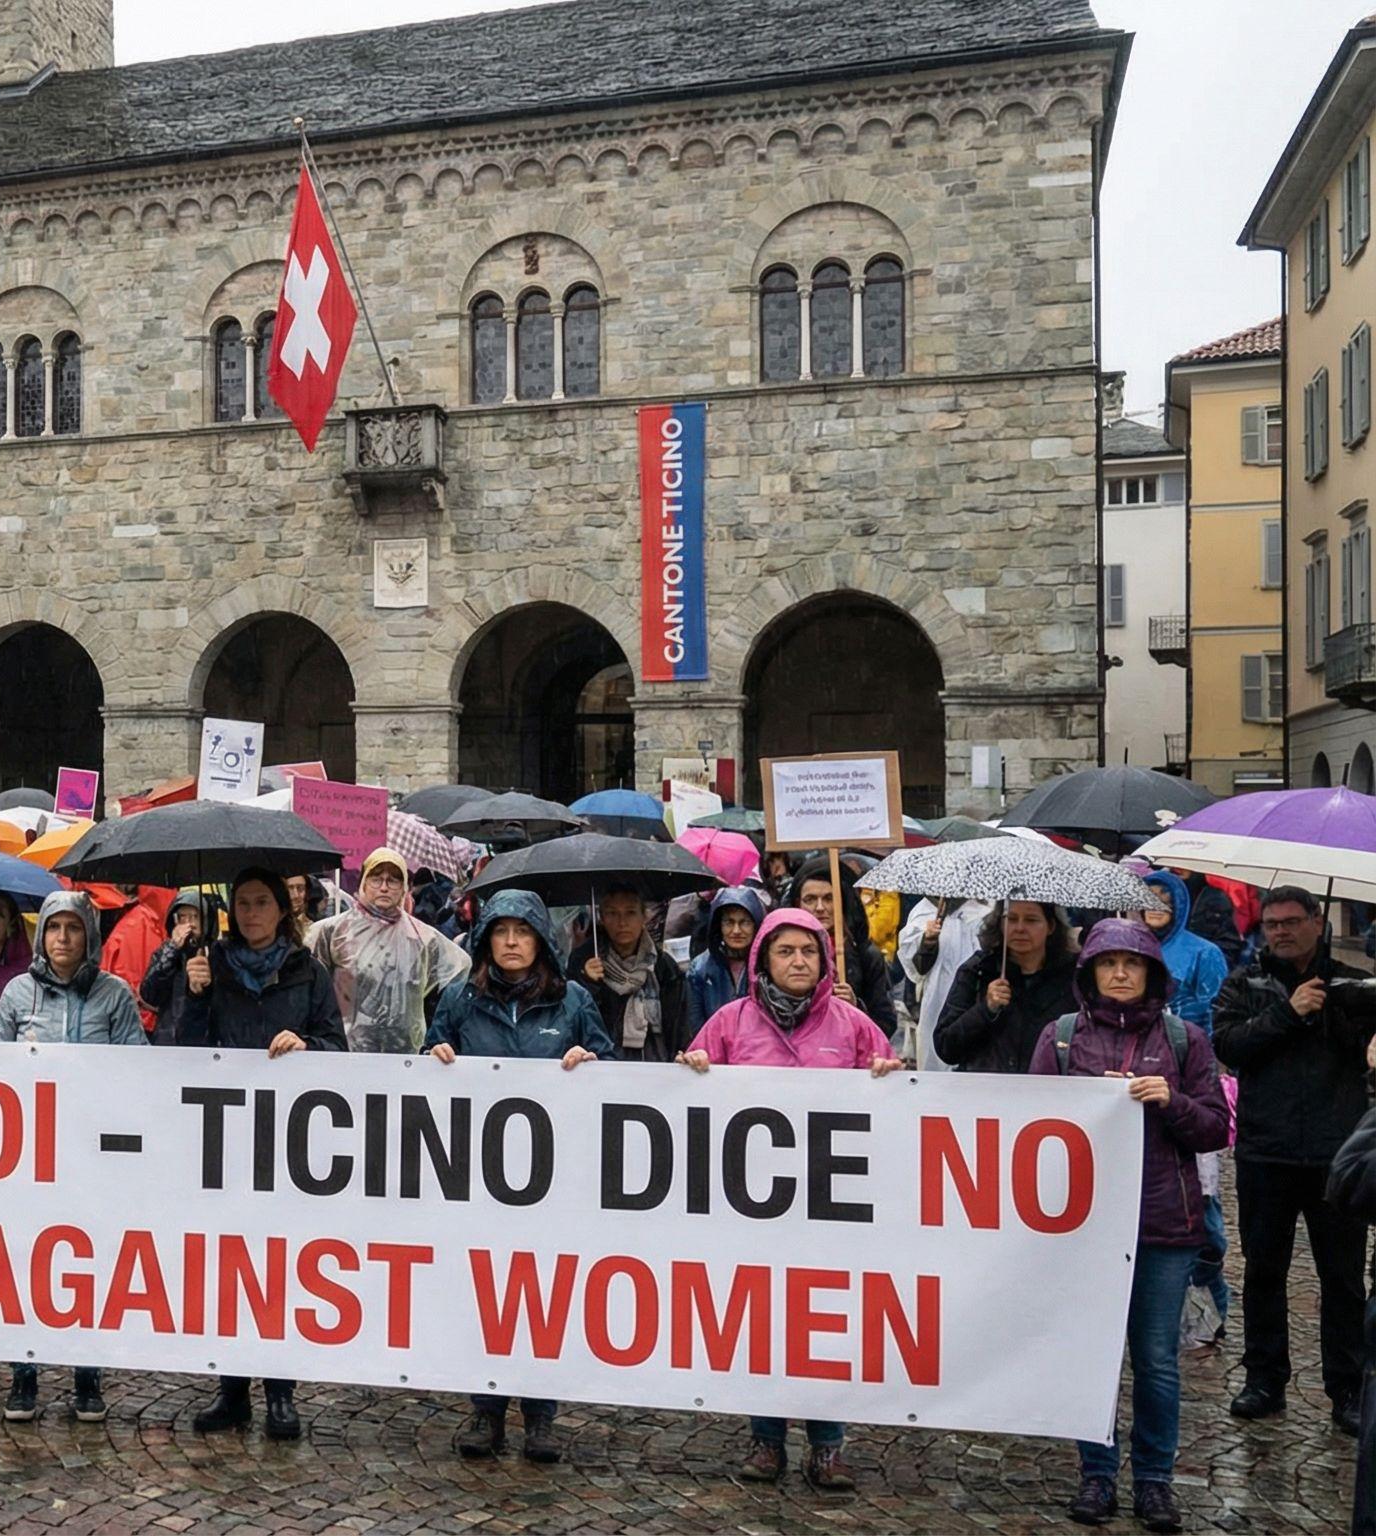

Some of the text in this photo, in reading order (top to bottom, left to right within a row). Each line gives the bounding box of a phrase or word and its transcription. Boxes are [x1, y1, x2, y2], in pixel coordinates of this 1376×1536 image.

[661, 418, 685, 663] CANTONE TICINO
[181, 1086, 555, 1207] TICINO
[600, 1102, 875, 1223] DICE
[919, 1115, 1094, 1233] NO
[469, 1248, 942, 1387] WOMEN
